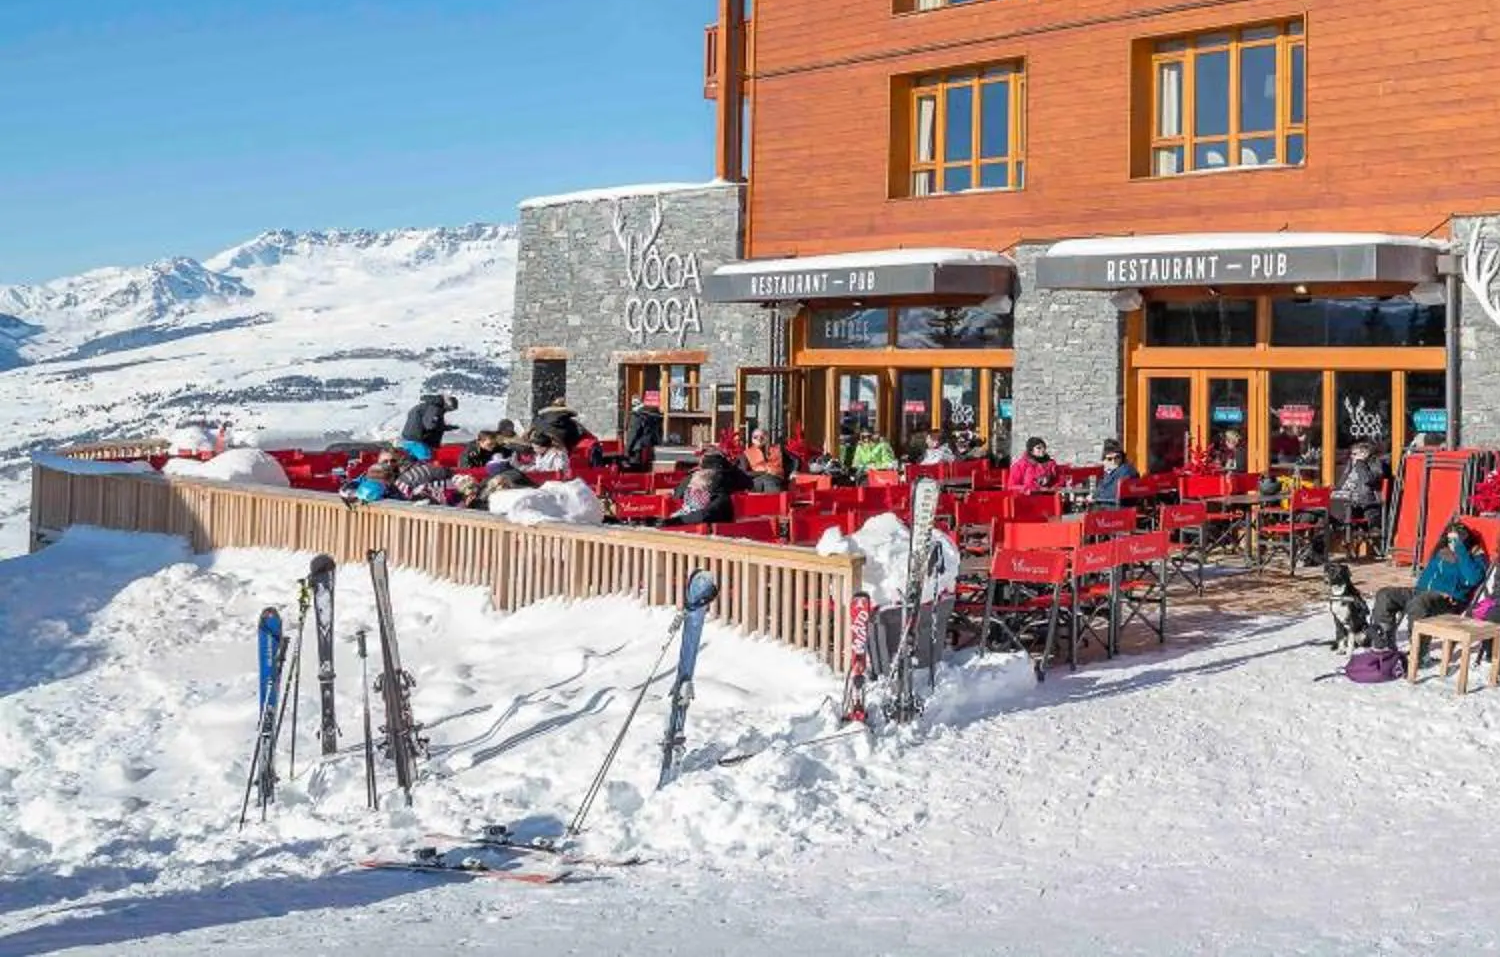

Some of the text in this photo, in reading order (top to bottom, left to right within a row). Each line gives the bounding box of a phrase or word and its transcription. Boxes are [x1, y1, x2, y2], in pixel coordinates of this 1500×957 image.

[1106, 255, 1219, 283] RESTAURANT
[1251, 252, 1288, 278] PUB
[751, 273, 829, 296] RESTAURANT
[849, 269, 876, 292] PUB
